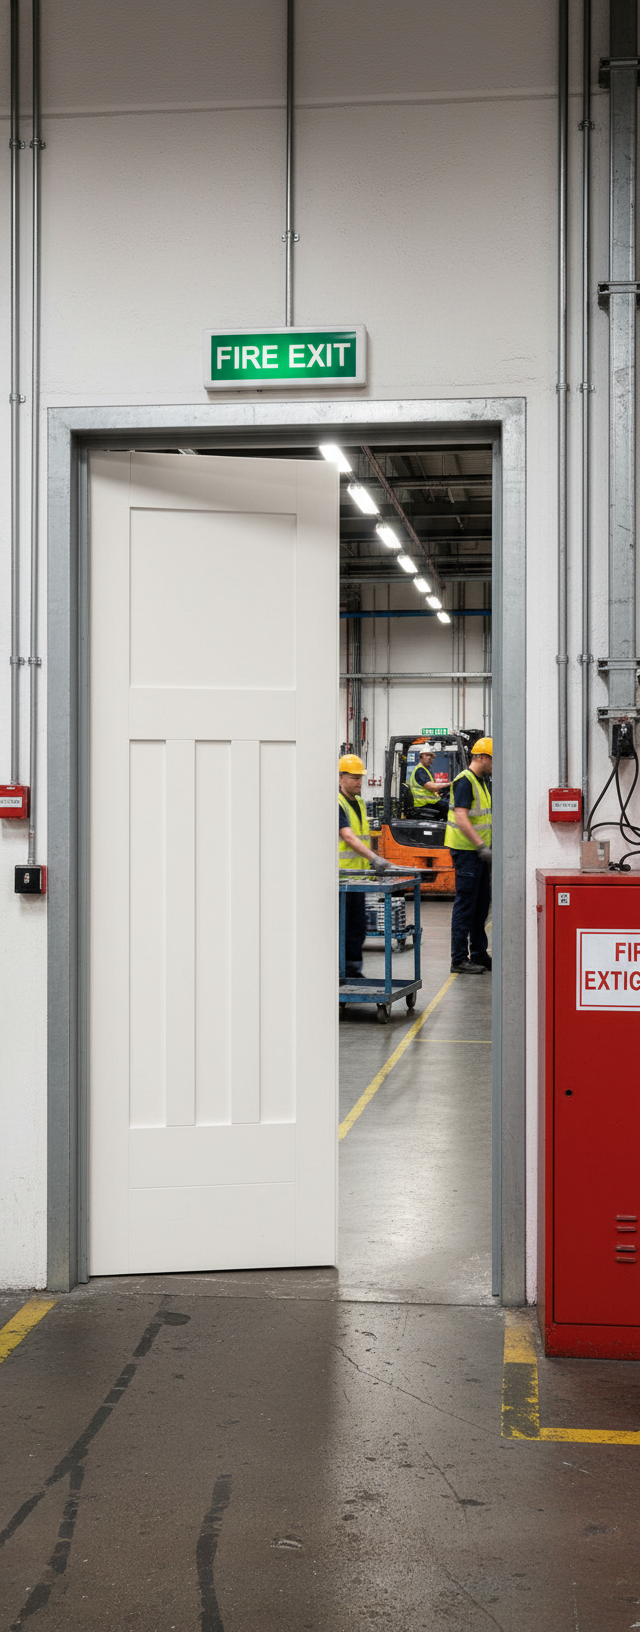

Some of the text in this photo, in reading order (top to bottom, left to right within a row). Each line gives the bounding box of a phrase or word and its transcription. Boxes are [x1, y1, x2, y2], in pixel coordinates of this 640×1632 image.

[217, 343, 351, 369] FIRE EXIT
[585, 970, 640, 991] EXTIG
